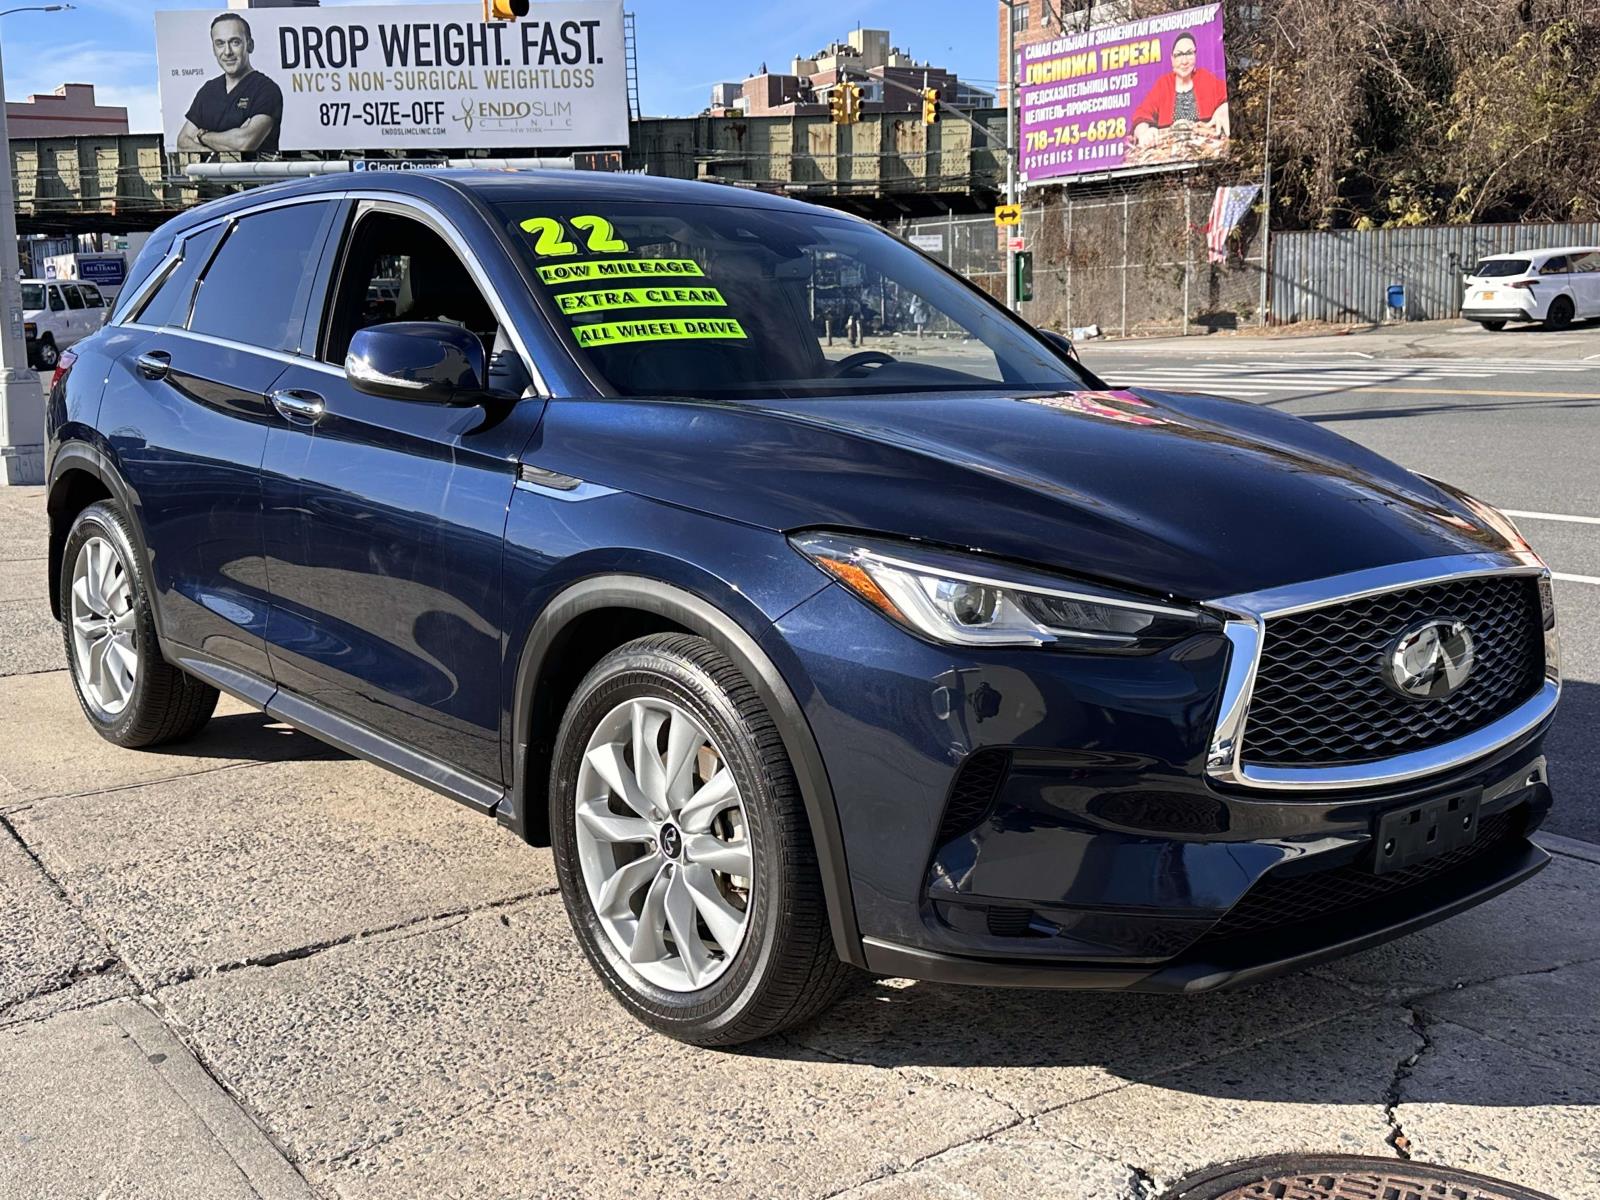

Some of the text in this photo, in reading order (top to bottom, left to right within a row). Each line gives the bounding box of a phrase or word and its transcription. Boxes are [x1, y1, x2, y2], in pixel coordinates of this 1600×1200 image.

[279, 20, 603, 69] DROP WEIGHT. FAST.
[1025, 6, 1216, 60] САМАЯ СИЛЬНАЯ И ЗНАМЕНИТАЯ ЯСНОВИДЯЩАЯ
[1026, 38, 1161, 85] ГОСПОЖА ТЕРЕЗА
[292, 69, 595, 93] NYC'S NON-SURGICAL WEIGHTLOSS
[1025, 72, 1138, 106] ПРЕДСКАЗАТЕЛЬНИЦА СУДЕБ
[319, 101, 445, 126] 877-SIZE-OFF
[478, 101, 572, 118] ENDOSLIM
[1025, 93, 1131, 125] ЦЕЛИТЕЛЬ-ПРОФЕССИОНАЛ
[381, 127, 447, 136] ENDOSLIMCLINIC.COM
[479, 119, 573, 128] CLINIC
[1025, 117, 1127, 153] 718-743-6828
[368, 162, 399, 172] Clear
[1025, 142, 1124, 170] PSYCHICS READING
[519, 215, 629, 256] 22
[542, 261, 697, 281] LOW MILEAGE
[561, 289, 720, 310] EXTRA CLEAN
[579, 321, 739, 343] ALL WHEEL DRIVE
